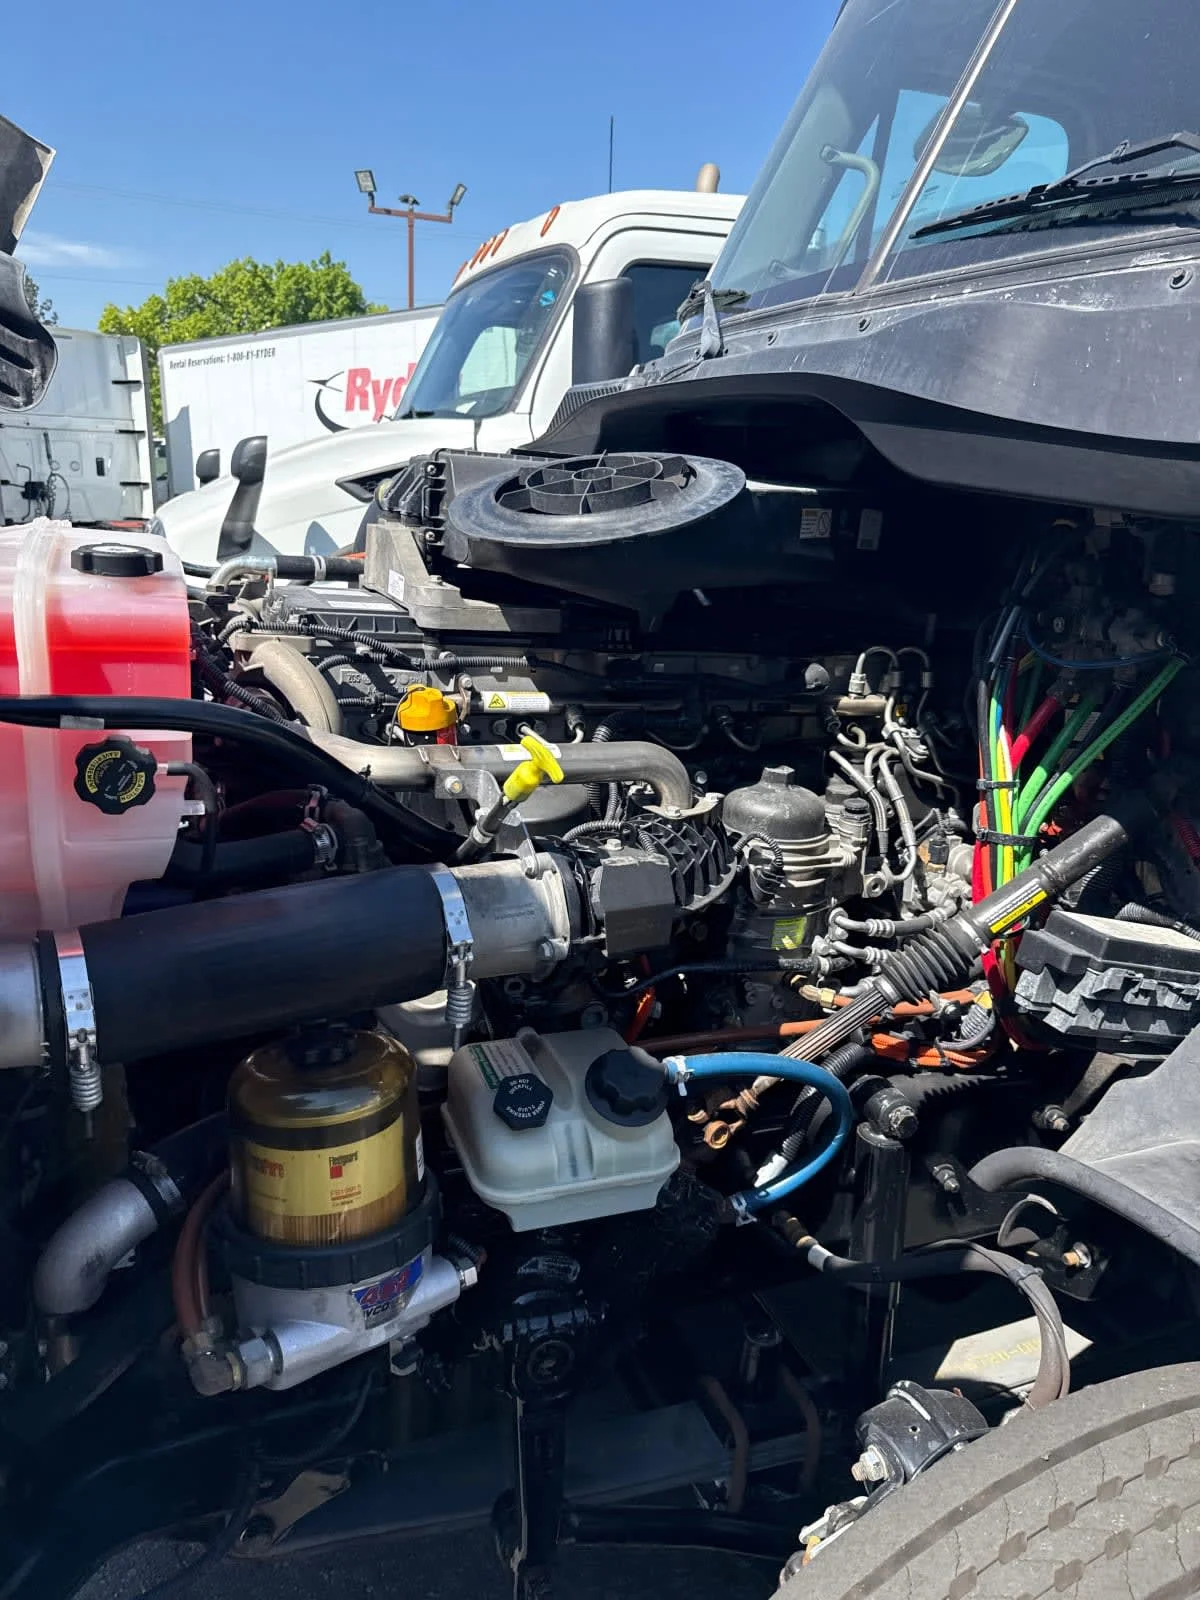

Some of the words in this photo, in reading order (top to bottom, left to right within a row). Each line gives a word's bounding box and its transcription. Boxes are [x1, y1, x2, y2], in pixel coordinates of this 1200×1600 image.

[169, 359, 186, 369] Rental
[188, 354, 225, 368] Reservations:
[345, 363, 417, 423] Ryd
[121, 778, 145, 802] CAUTION
[517, 1104, 536, 1113] FLUID
